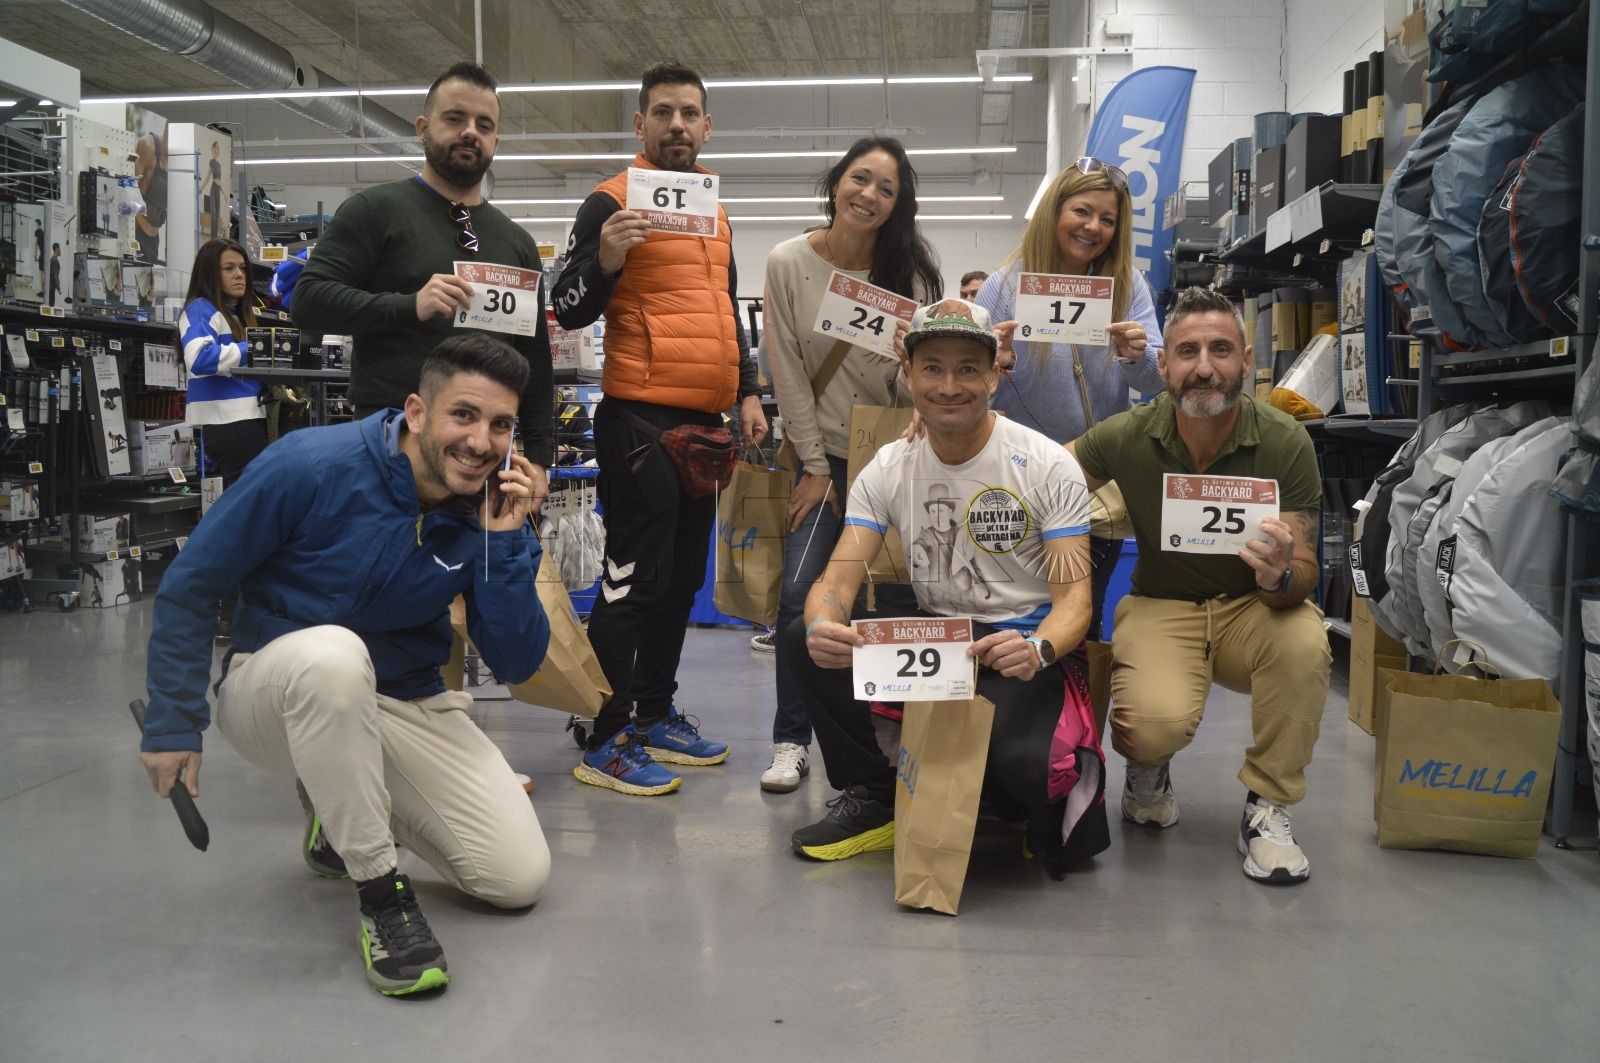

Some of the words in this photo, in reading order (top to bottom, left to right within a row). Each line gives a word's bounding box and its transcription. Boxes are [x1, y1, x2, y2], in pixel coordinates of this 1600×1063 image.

[652, 186, 687, 209] 19
[485, 271, 521, 286] BACKYARD
[1049, 282, 1092, 294] BACKYARD
[483, 289, 516, 315] 30
[856, 289, 897, 312] BACKYARD
[849, 306, 885, 336] 24
[1049, 300, 1086, 325] 17
[856, 428, 877, 451] 24
[1201, 484, 1253, 498] BACKYARD
[970, 509, 1025, 524] BACKYARD
[1201, 506, 1246, 535] 25
[975, 531, 1021, 542] CARTAGENA
[986, 524, 1009, 532] ULTRA
[1440, 546, 1453, 567] BLACK
[1358, 571, 1367, 592] FRESH
[893, 626, 946, 639] BACKYARD
[896, 647, 941, 677] 29
[1397, 758, 1538, 799] MELILLA
